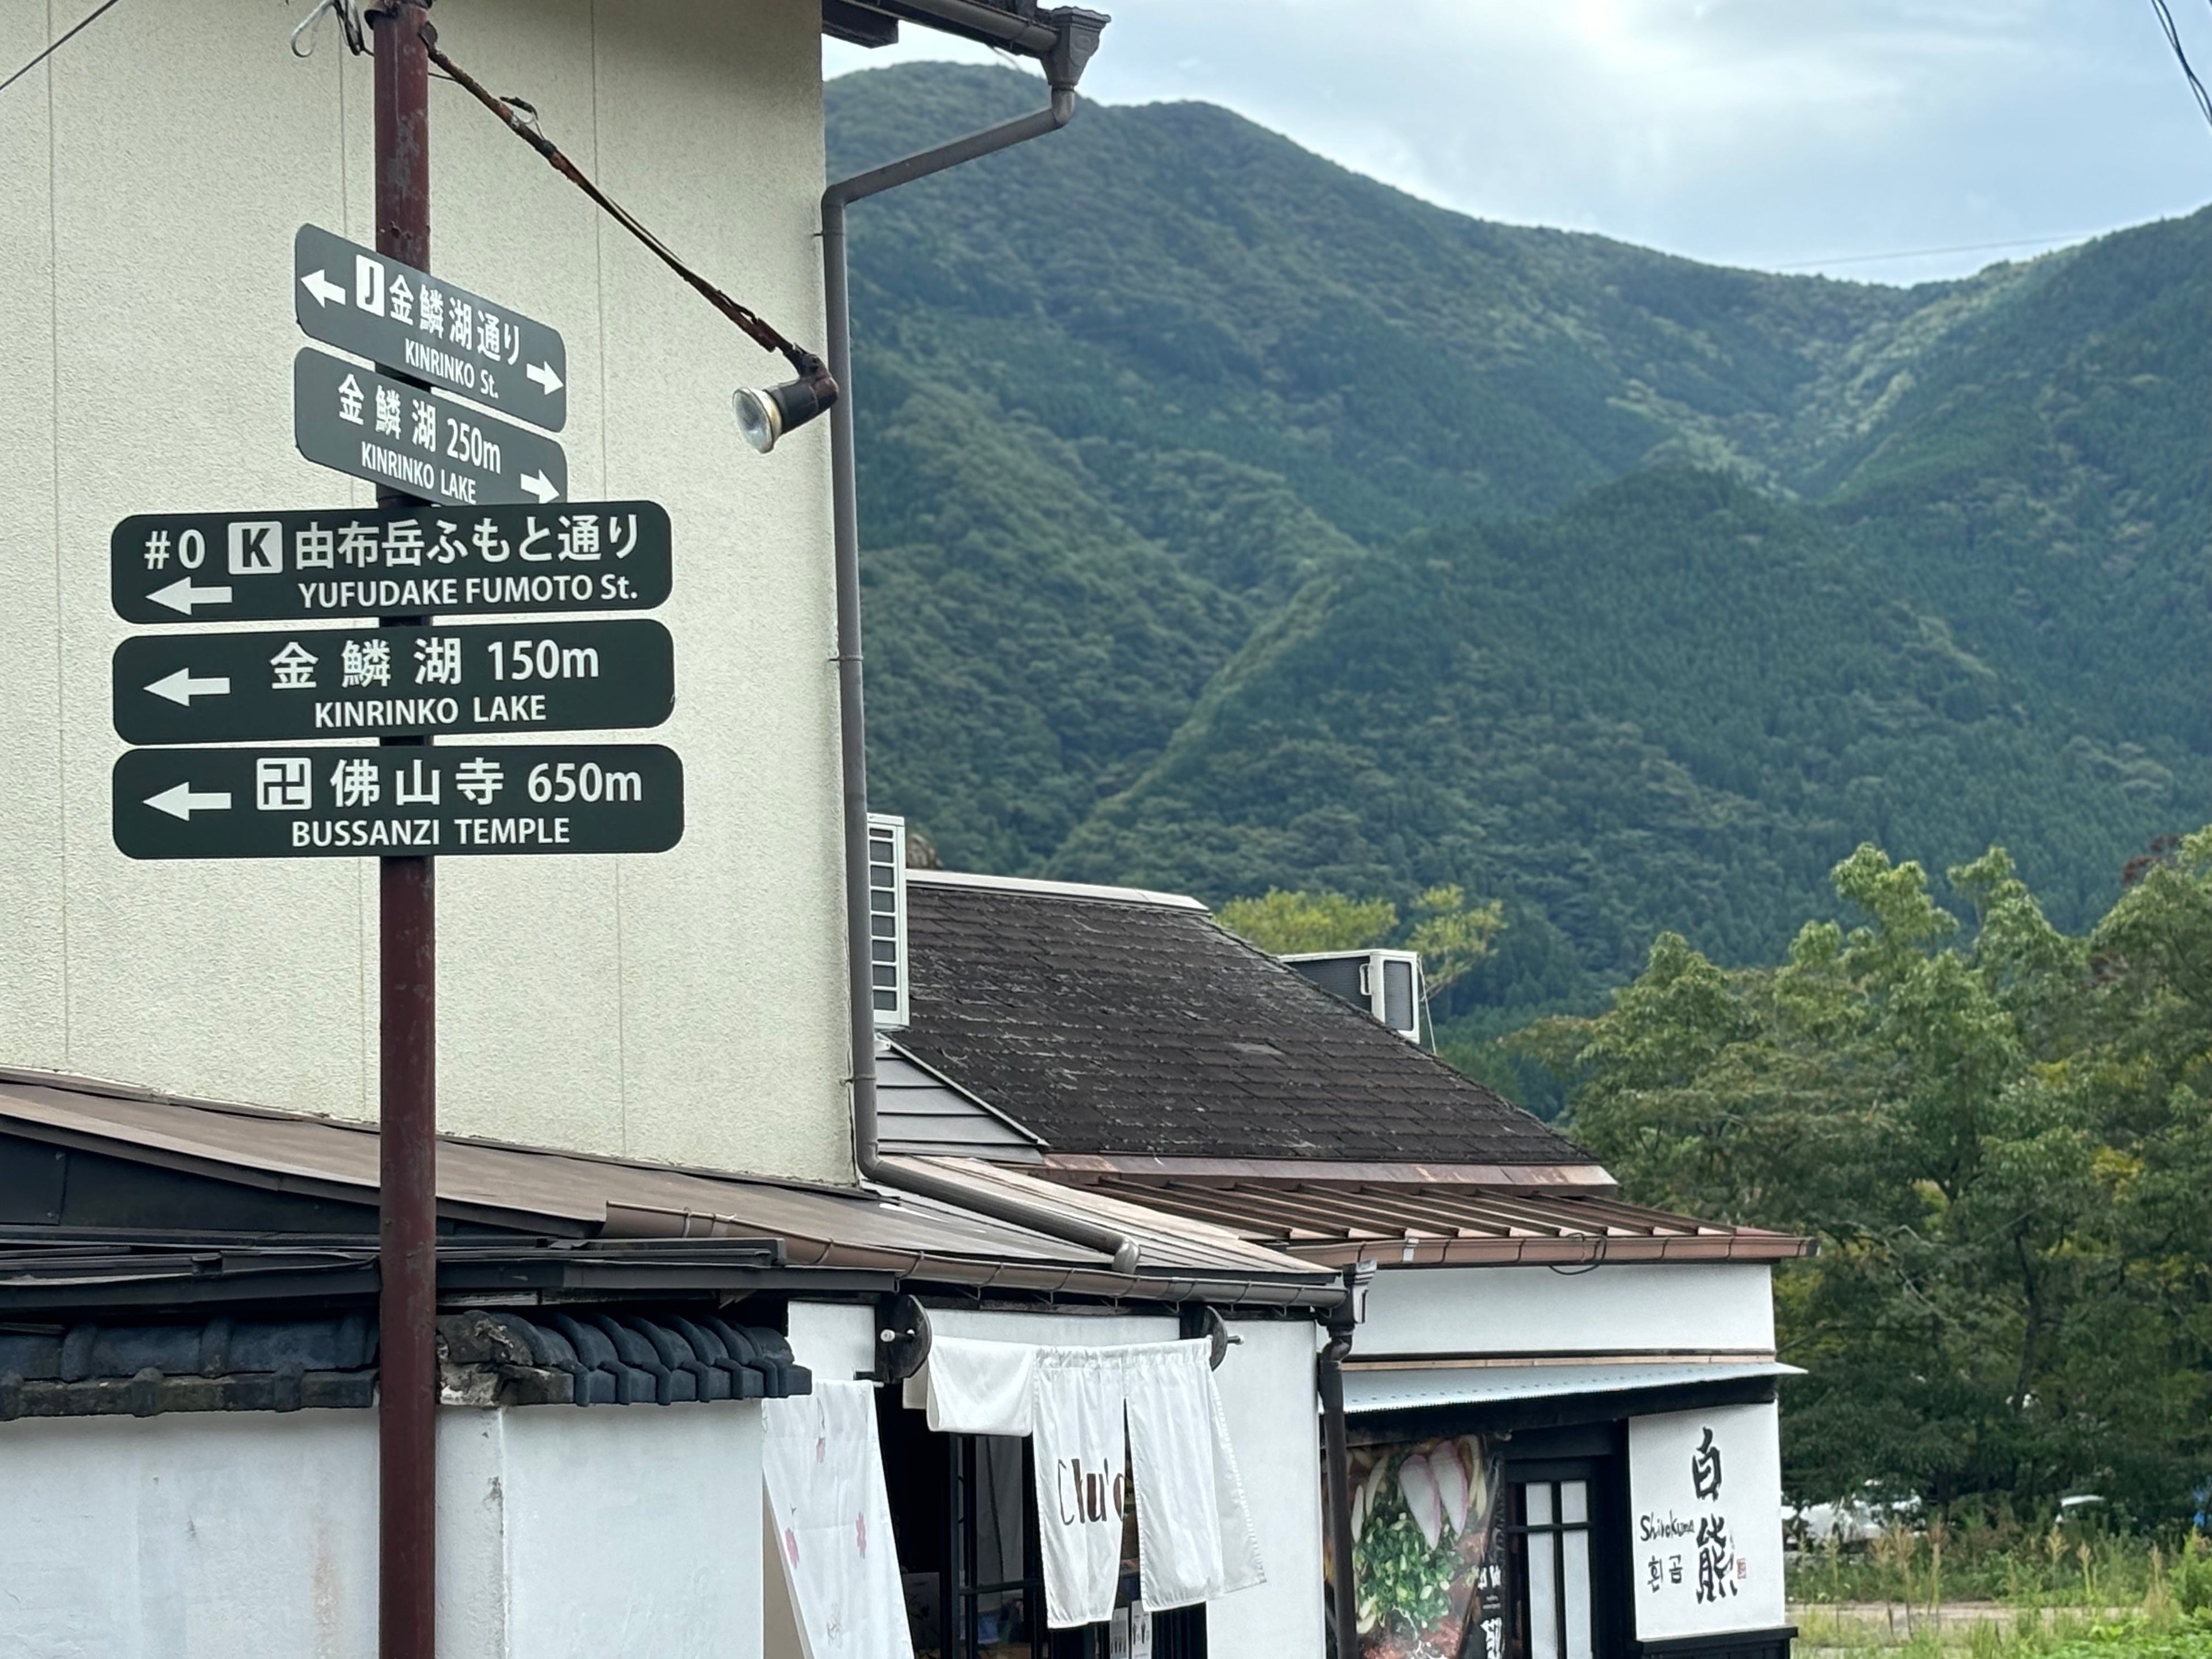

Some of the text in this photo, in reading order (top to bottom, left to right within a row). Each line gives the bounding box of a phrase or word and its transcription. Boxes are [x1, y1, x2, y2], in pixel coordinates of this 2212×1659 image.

[389, 274, 520, 366] 金鱗湖通り
[404, 338, 499, 399] KINRINKO St.
[338, 373, 501, 475] 金鱗湖 250m
[361, 441, 477, 505] KINRINKO LAKE
[144, 529, 205, 570] #0
[296, 514, 638, 570] 由布岳ふもと通り
[298, 573, 638, 608] YUFUDAKE FUMOTO St.
[270, 637, 599, 691] 金鱗湖 150m
[315, 695, 547, 728] KINRINKO LAKE
[329, 757, 642, 808] 佛山寺 650m
[292, 817, 570, 847] BUSSANZI TEMPLE
